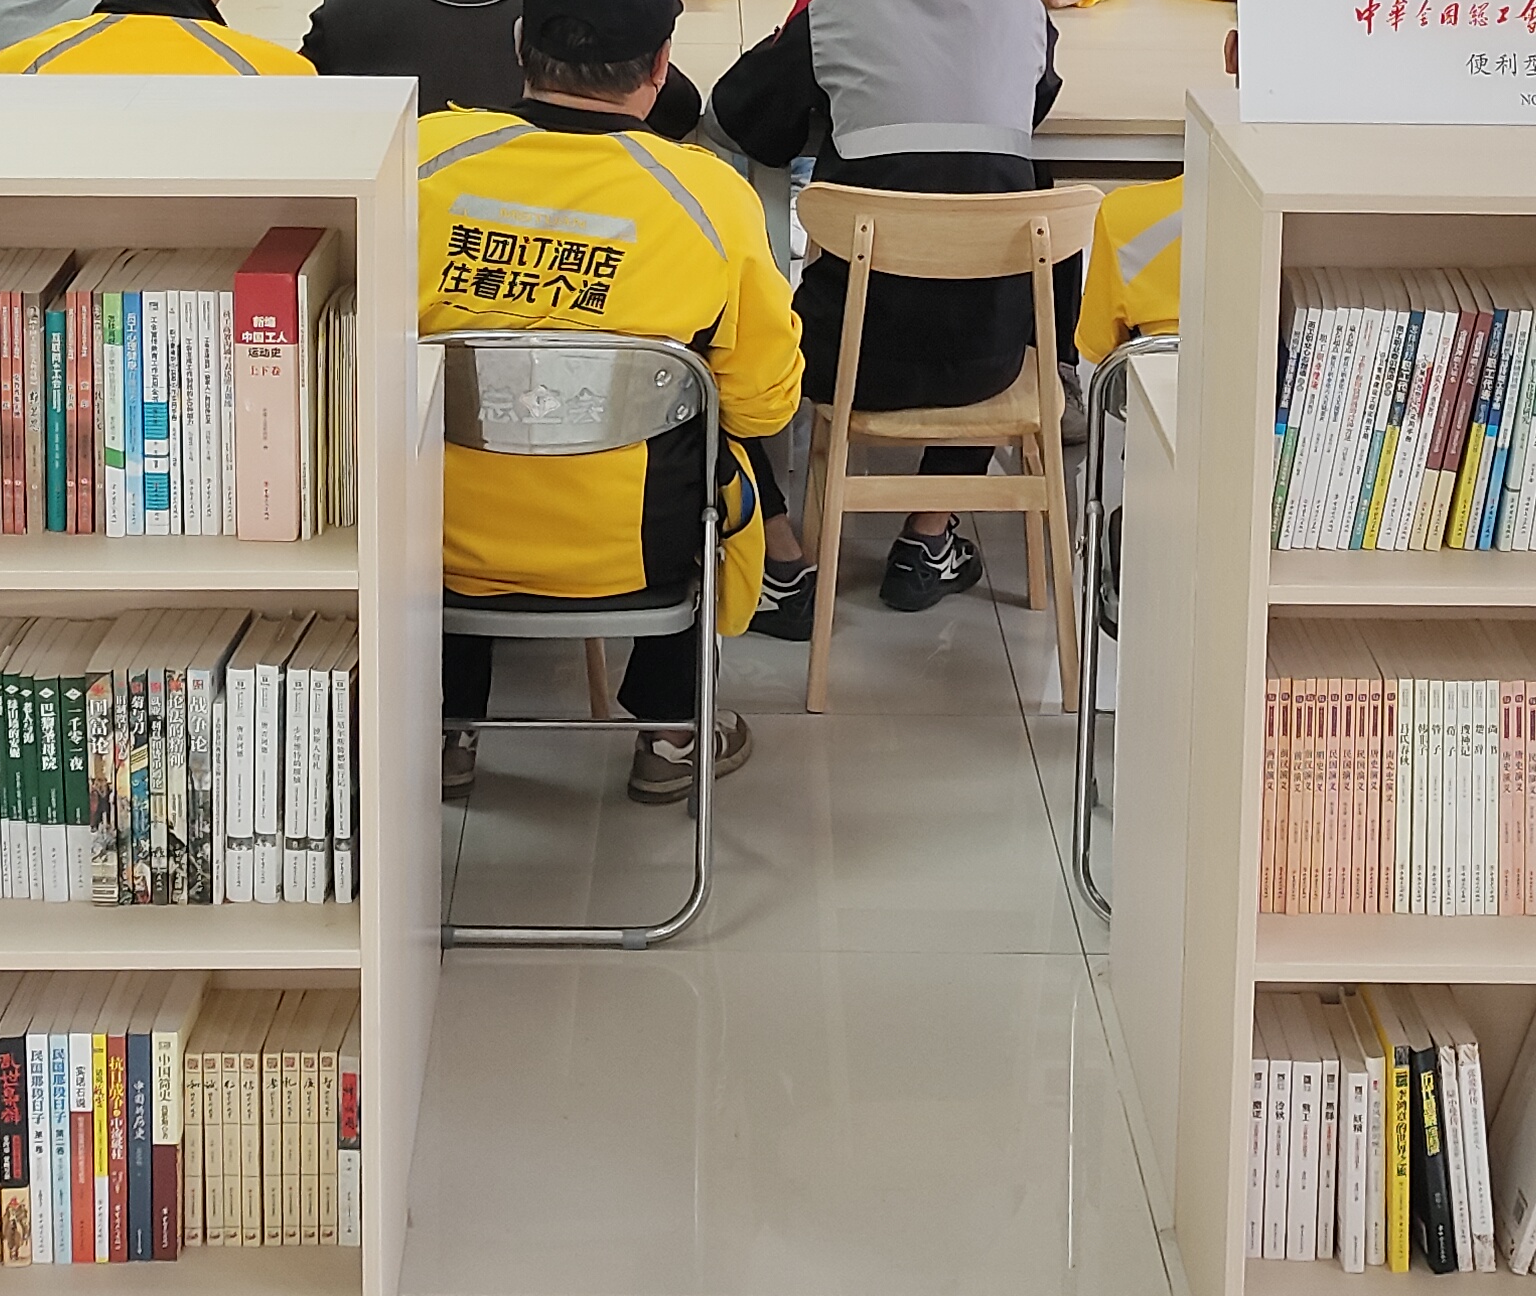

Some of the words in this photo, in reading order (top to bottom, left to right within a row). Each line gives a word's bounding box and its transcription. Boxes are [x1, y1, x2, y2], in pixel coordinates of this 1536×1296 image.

[447, 224, 626, 280] 美团订酒店
[437, 262, 612, 315] 住着玩个遍
[241, 330, 288, 344] 中国工人
[247, 346, 282, 359] 运动史
[40, 702, 58, 771] 巴黎圣母院
[67, 708, 84, 771] 一千零一夜
[89, 698, 110, 755] 国富论
[131, 695, 145, 735] 菊与刀
[168, 695, 184, 767] 论法的精神
[188, 696, 208, 753] 战争论
[30, 1049, 45, 1125] 民国那段日子
[52, 1048, 67, 1124] 民国那段日子
[158, 1054, 172, 1102] 中国简史
